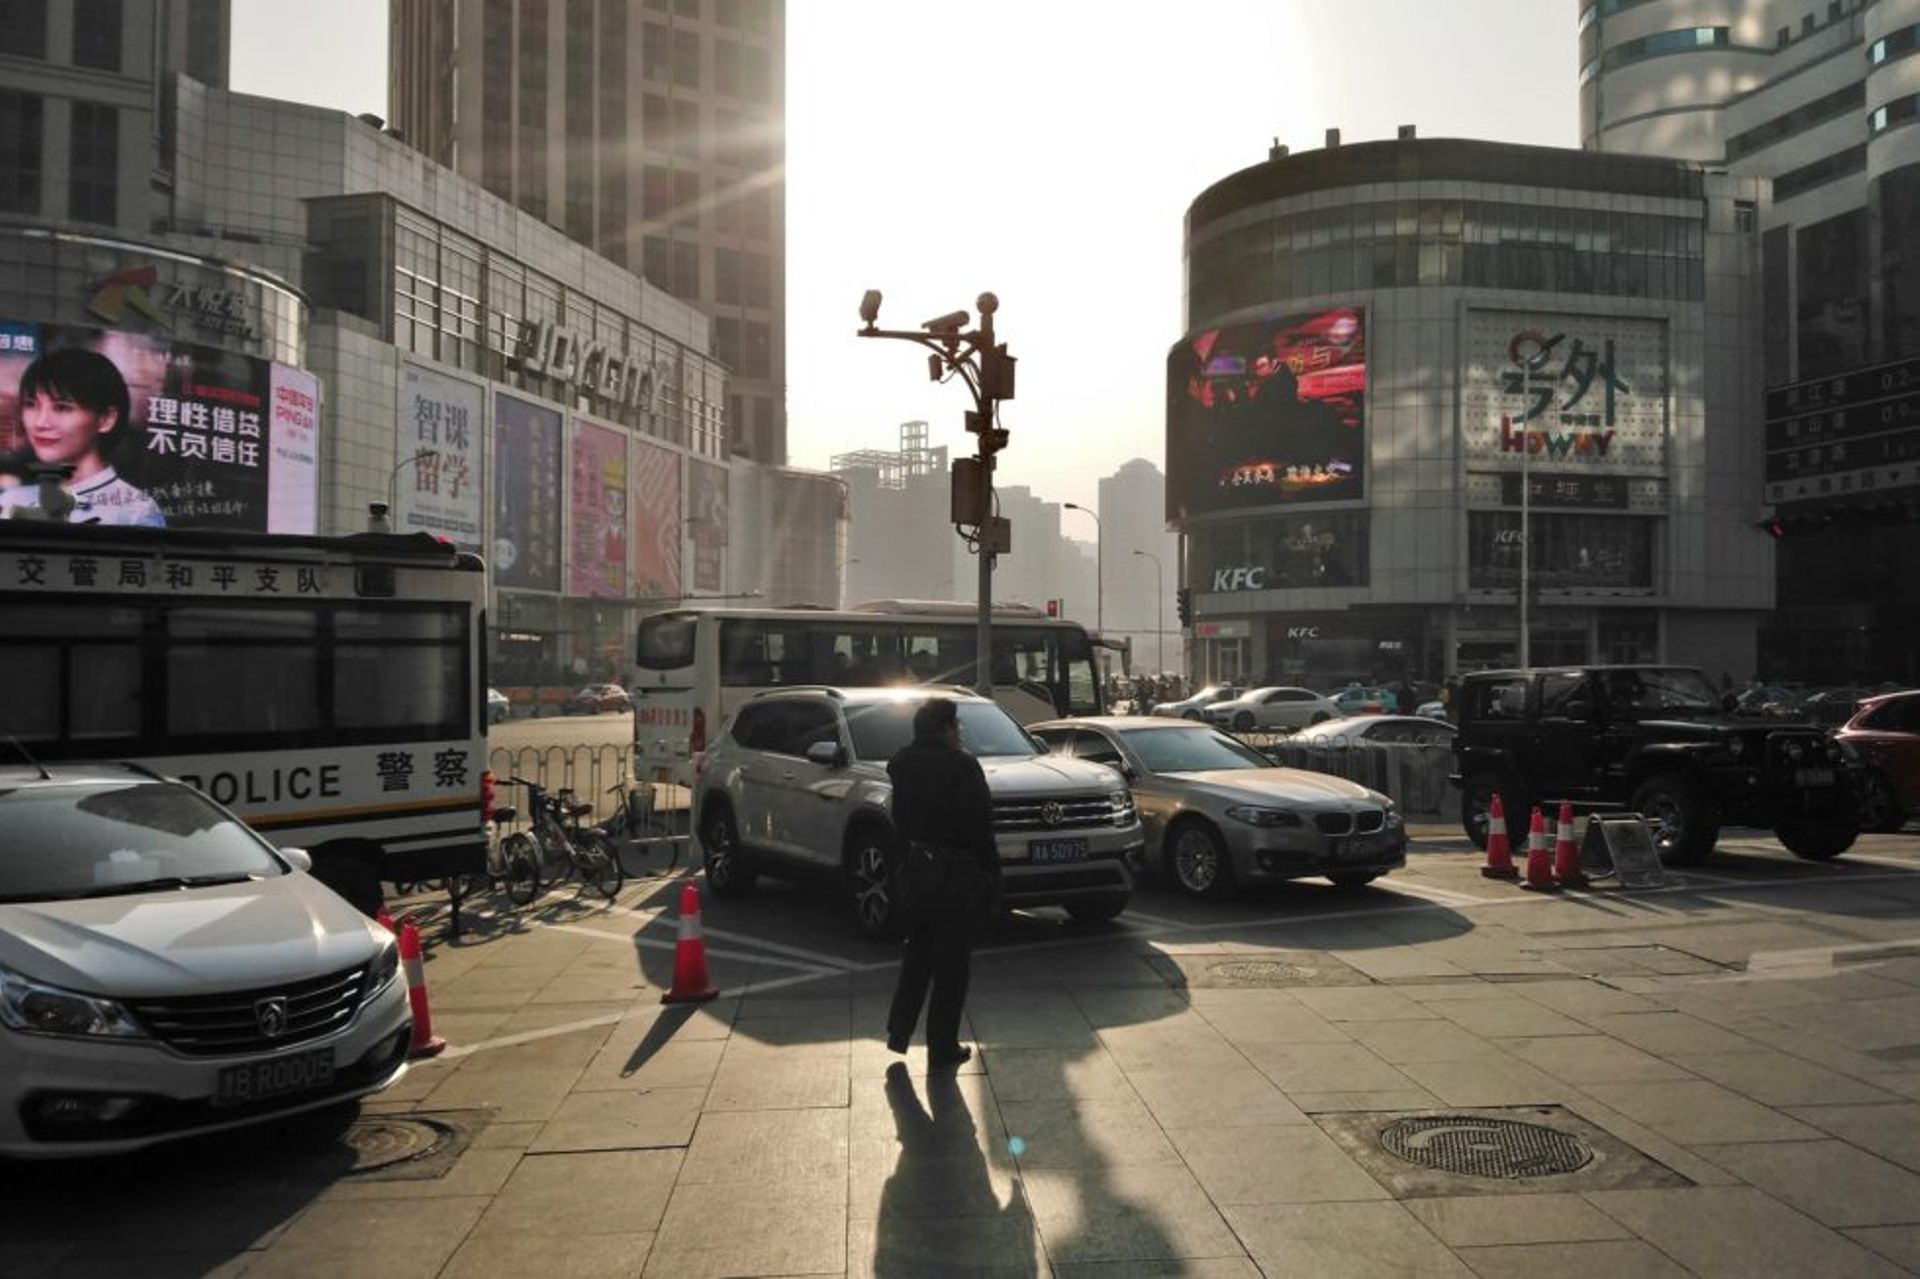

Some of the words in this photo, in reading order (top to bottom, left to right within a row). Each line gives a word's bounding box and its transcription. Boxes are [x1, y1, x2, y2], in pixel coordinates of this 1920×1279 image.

[1501, 332, 1630, 428] 号外
[147, 396, 260, 439] 理性借贷
[414, 394, 470, 450] 智课
[147, 427, 260, 468] 不负信任
[414, 446, 470, 500] 留学
[17, 557, 322, 594] 交管局和平支队
[1212, 566, 1266, 592] KFC
[1287, 626, 1320, 639] KFC
[375, 748, 468, 792] 警察
